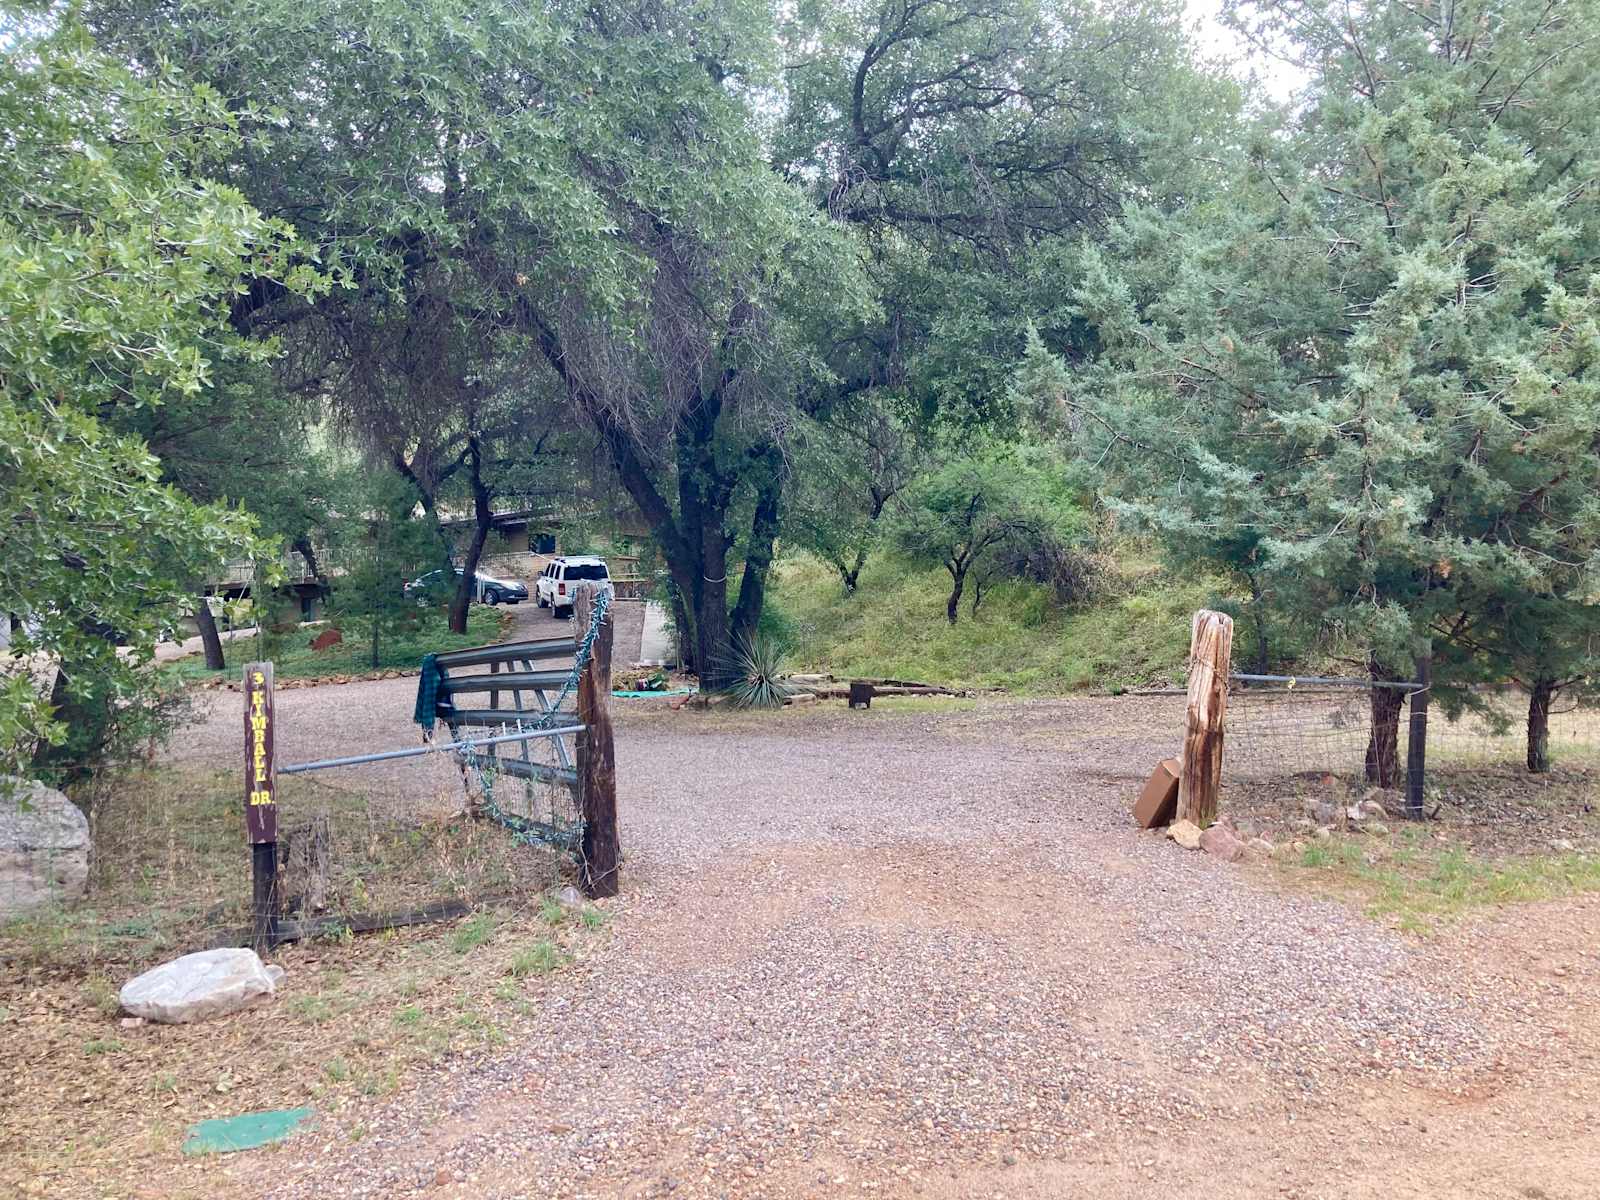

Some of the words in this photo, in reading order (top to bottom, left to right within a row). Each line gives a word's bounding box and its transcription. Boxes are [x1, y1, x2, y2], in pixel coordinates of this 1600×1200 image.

[252, 671, 265, 685] 3
[251, 691, 267, 782] KIMBALL
[250, 791, 276, 806] DR.
